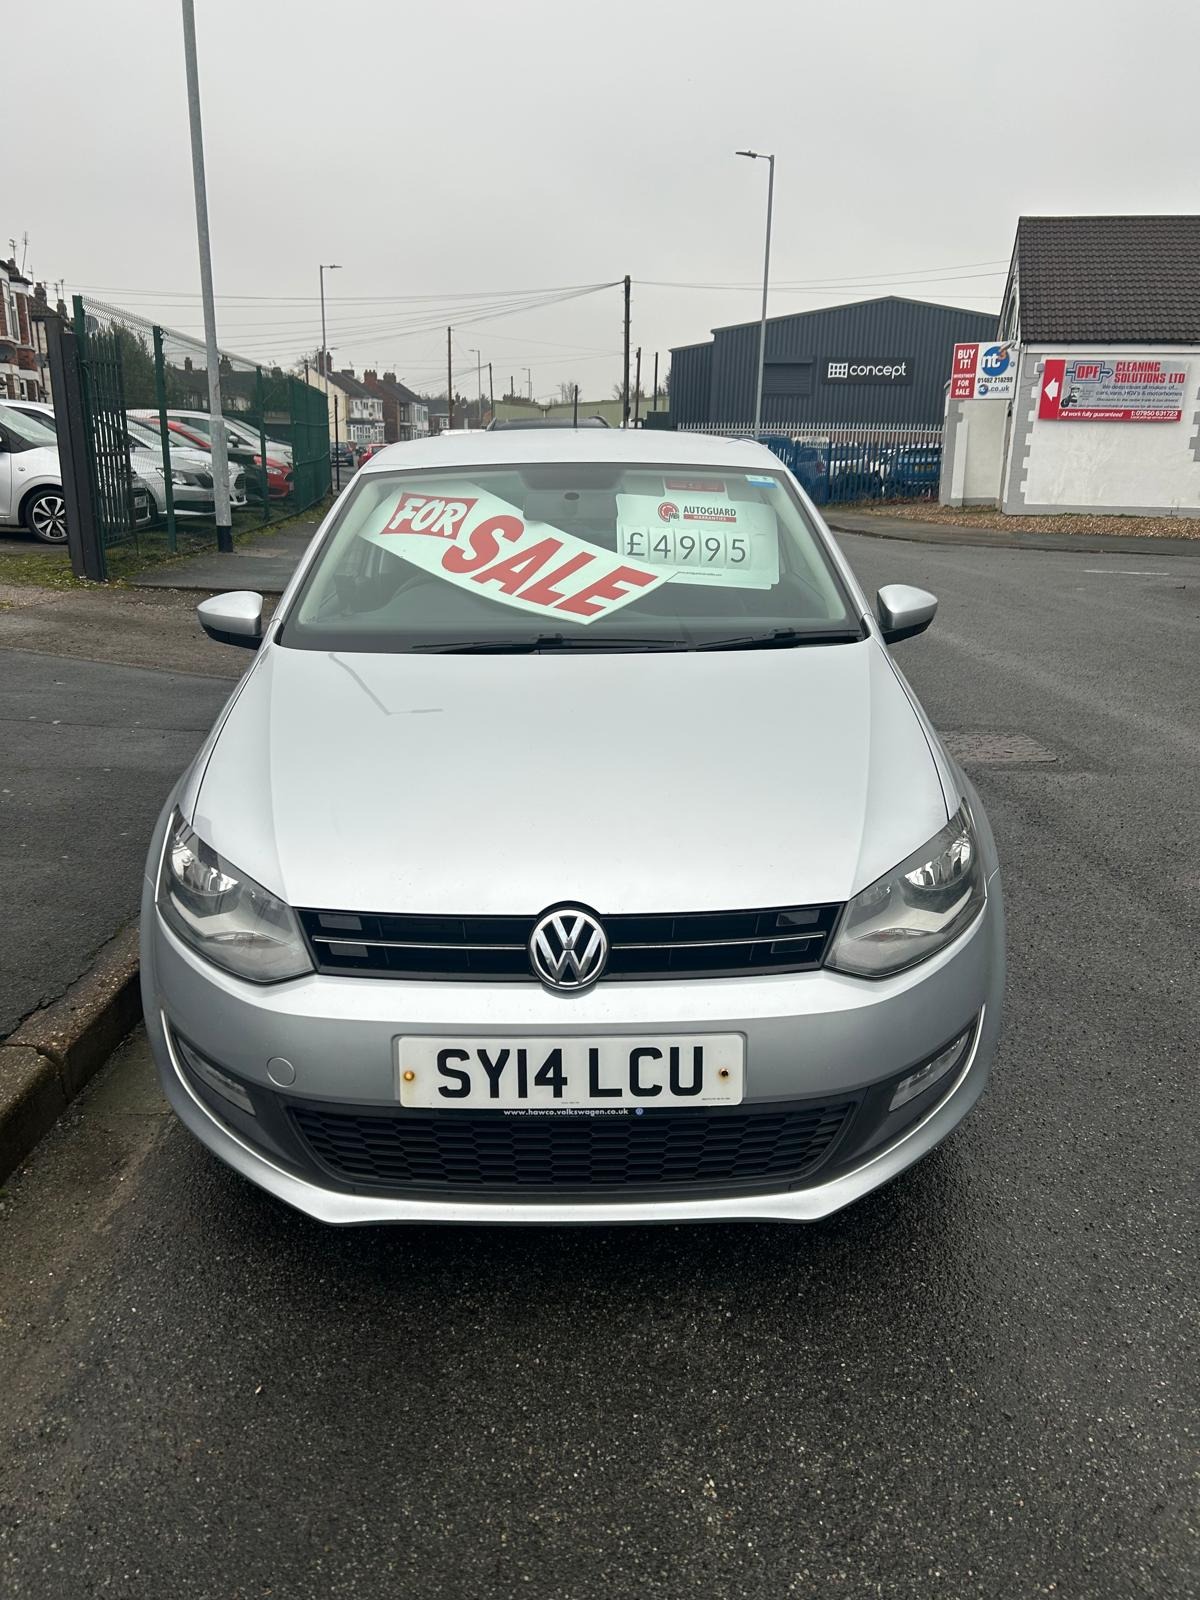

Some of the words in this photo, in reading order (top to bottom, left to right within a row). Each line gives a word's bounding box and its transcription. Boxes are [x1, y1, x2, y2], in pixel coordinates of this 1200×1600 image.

[957, 349, 976, 359] BUY
[960, 360, 972, 369] IT!
[1115, 361, 1161, 372] CLEANING
[850, 362, 906, 379] concept
[1077, 365, 1100, 379] DPF
[957, 379, 970, 387] FOR
[1114, 373, 1166, 383] SOLUTIONS
[1168, 373, 1186, 383] LTD
[955, 388, 970, 396] SALE
[389, 498, 467, 536] FOR
[683, 506, 737, 517] AUTOGUARD
[627, 532, 746, 563] £4995
[442, 515, 659, 616] SALE
[436, 1047, 568, 1099] SY14
[589, 1046, 704, 1098] LCU
[503, 1107, 629, 1118] www.hawco.volkswagen.co.uk
